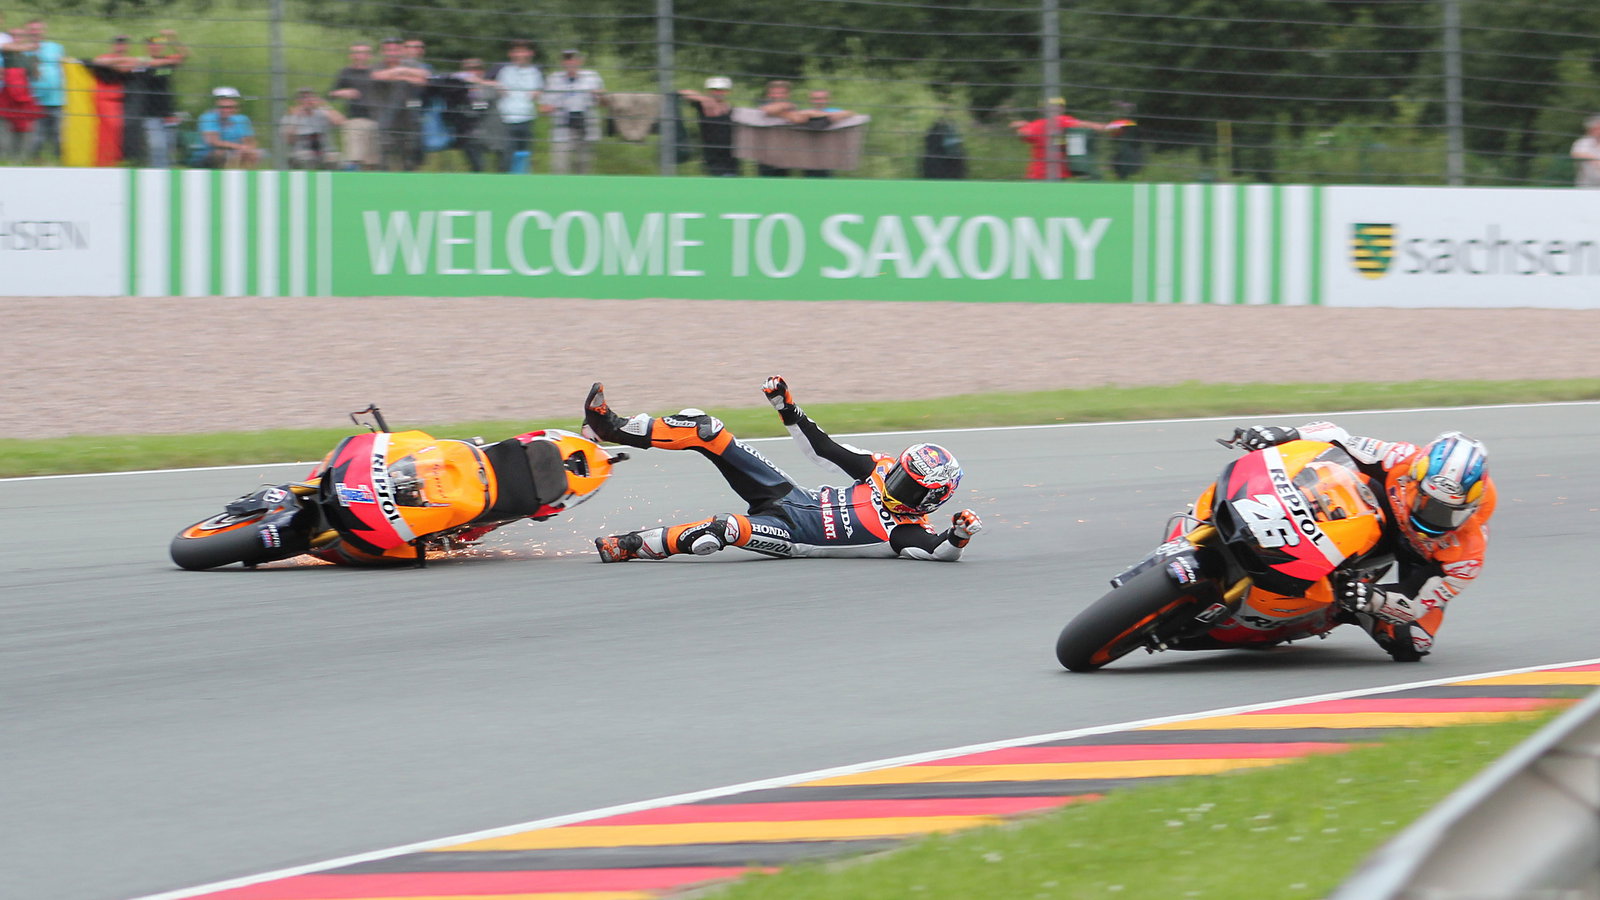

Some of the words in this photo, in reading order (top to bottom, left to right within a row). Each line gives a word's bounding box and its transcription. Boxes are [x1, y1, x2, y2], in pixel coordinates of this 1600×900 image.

[362, 209, 706, 276] WELCOME
[719, 212, 806, 278] TO
[820, 213, 1112, 280] SAXONY
[374, 453, 400, 524] REPSOL
[838, 487, 854, 539] HONDA
[1270, 468, 1324, 546] REPSOL
[751, 523, 791, 540] HONDA
[1231, 494, 1300, 548] 26
